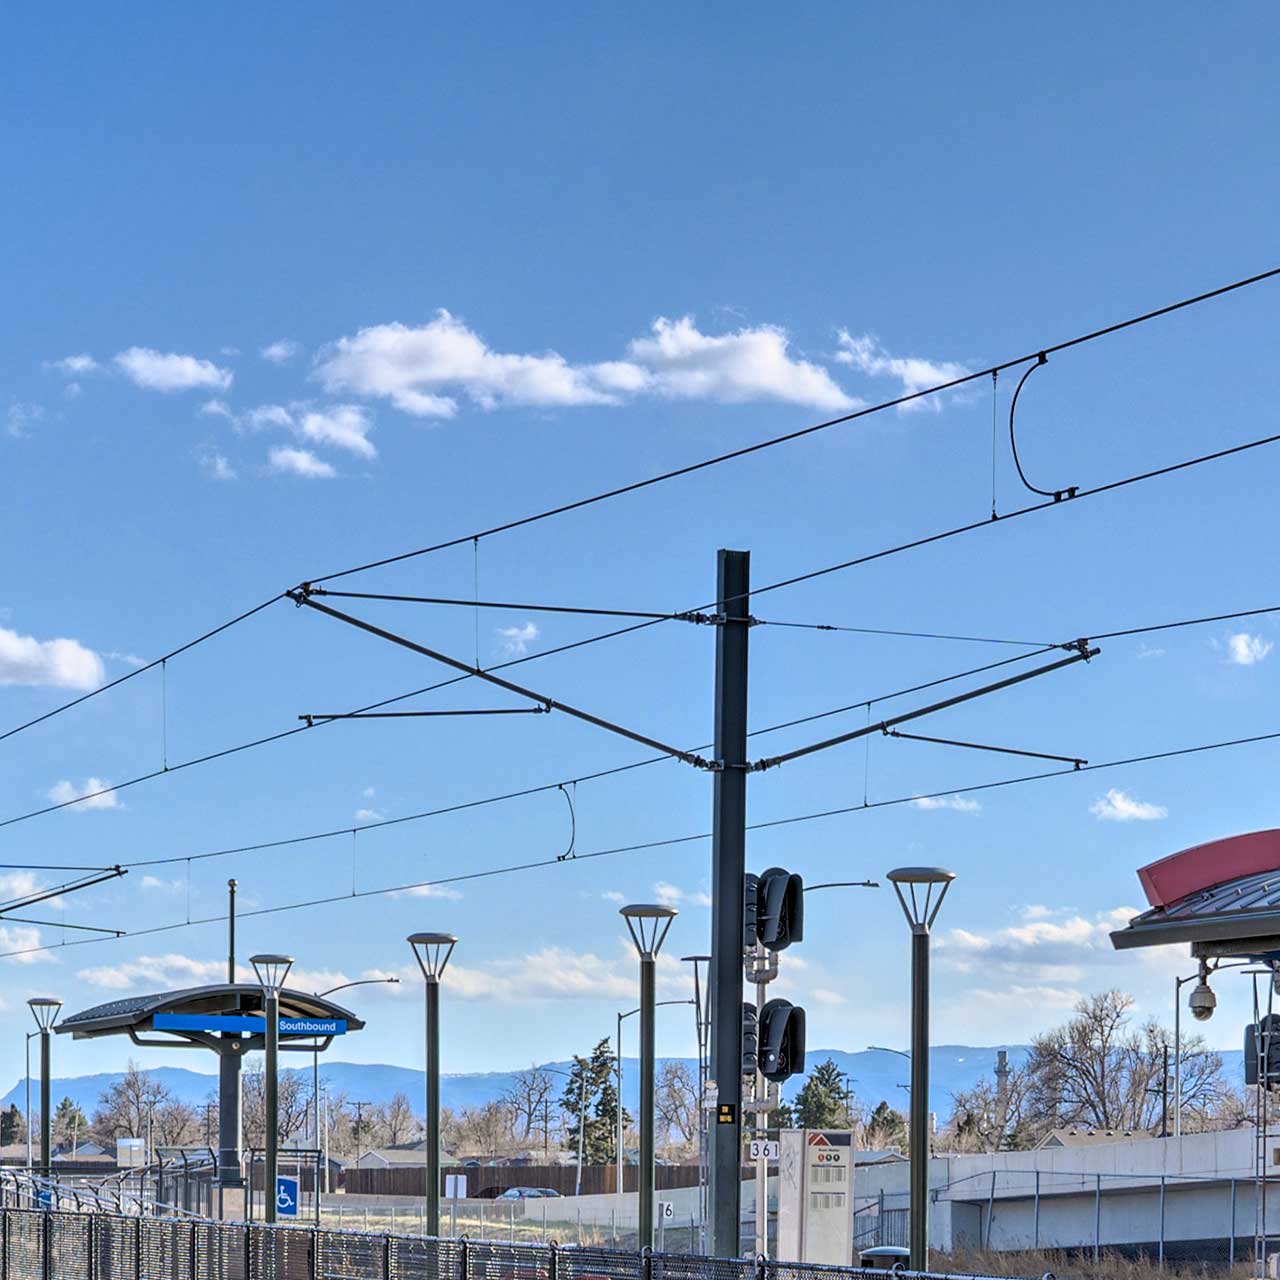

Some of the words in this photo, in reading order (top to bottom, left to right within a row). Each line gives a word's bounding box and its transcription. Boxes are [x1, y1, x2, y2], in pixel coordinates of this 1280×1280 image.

[279, 1020, 336, 1031] Southbound
[752, 1143, 778, 1157] 361
[665, 1203, 673, 1217] 6
